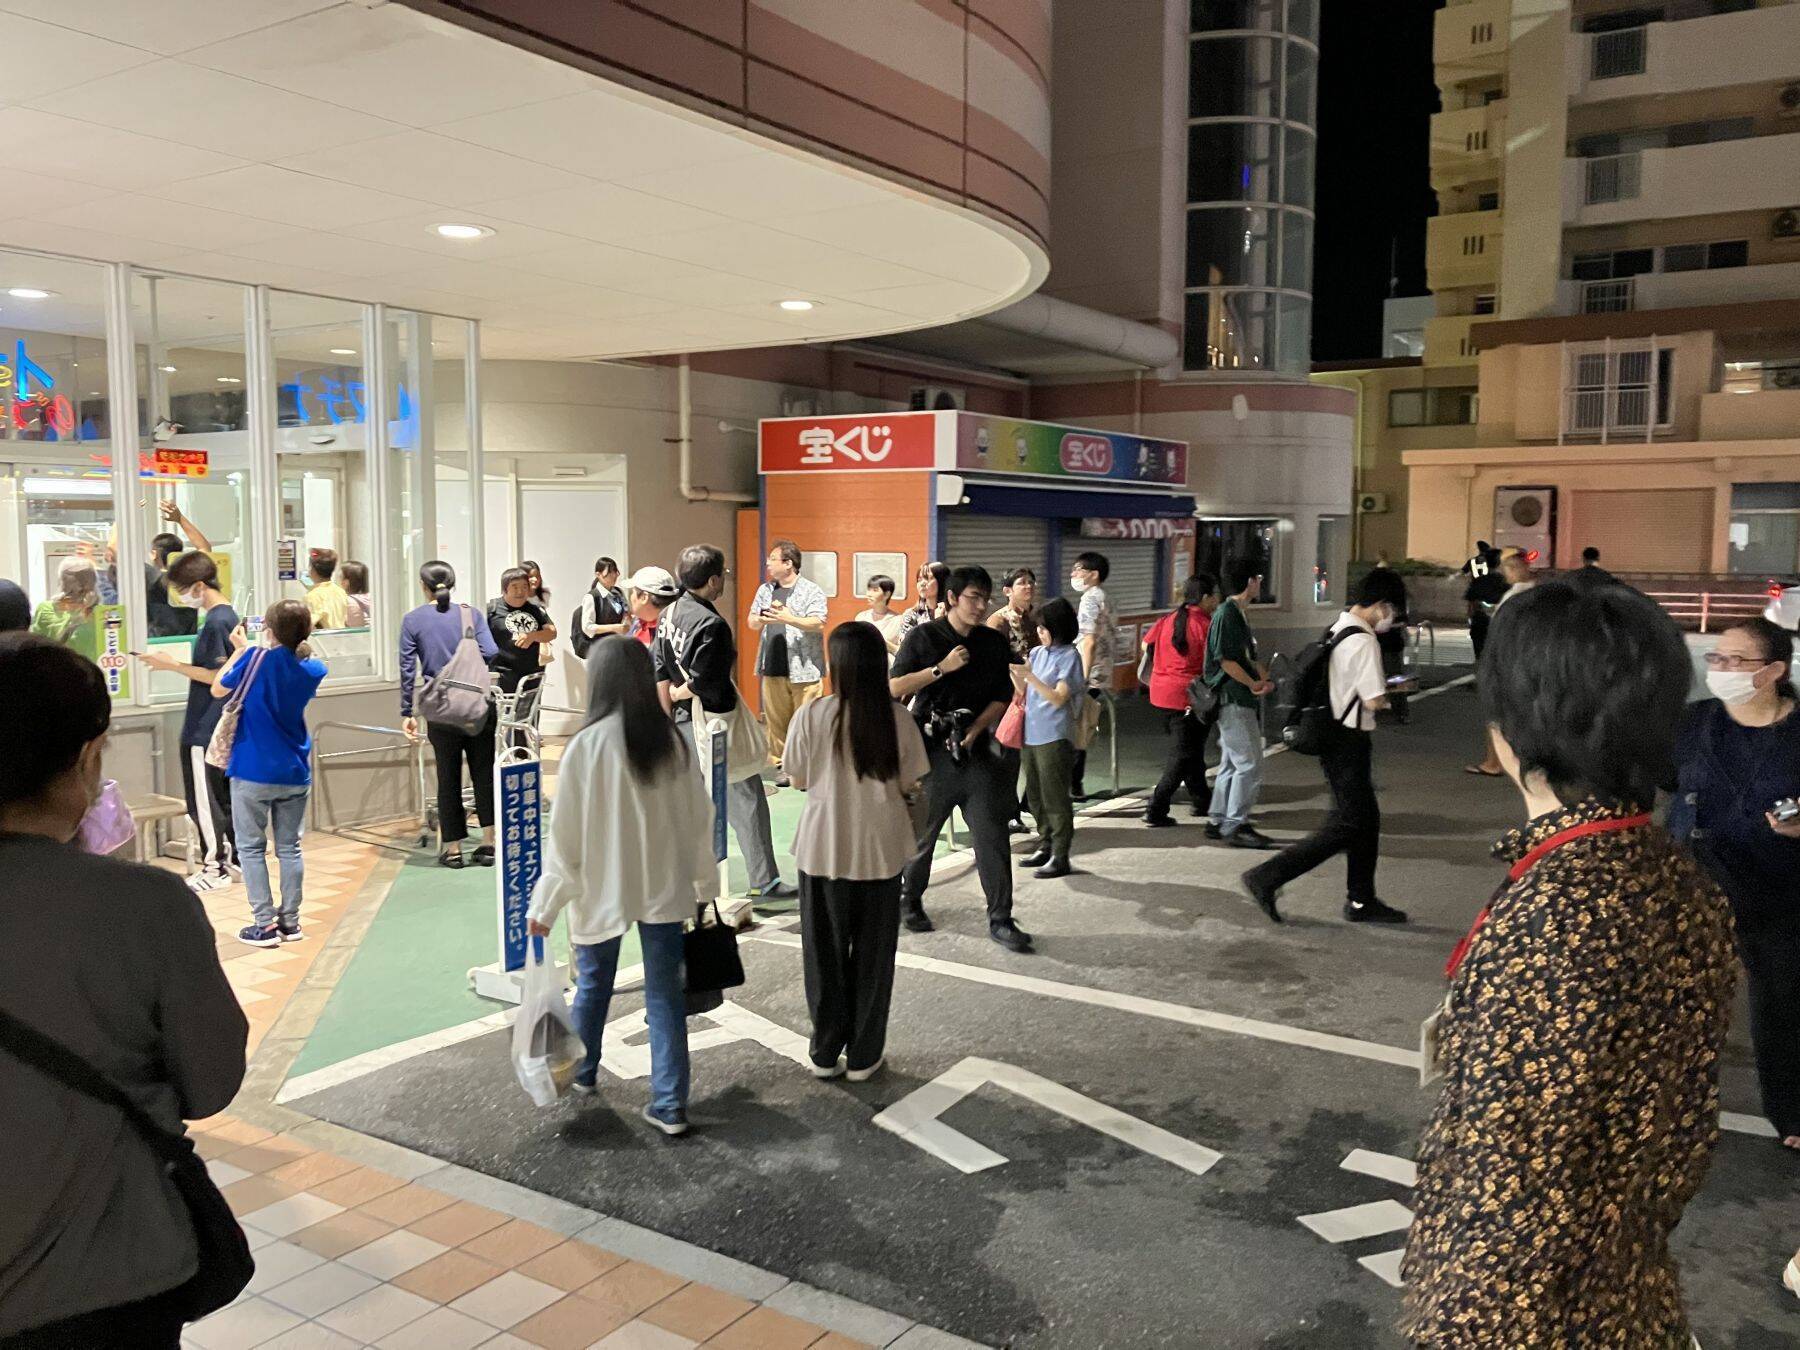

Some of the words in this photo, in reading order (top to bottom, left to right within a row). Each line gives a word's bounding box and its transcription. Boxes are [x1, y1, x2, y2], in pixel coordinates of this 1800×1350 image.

[799, 425, 893, 464] 宝くじ
[1068, 440, 1106, 467] 宝くじ
[101, 656, 125, 668] 110
[505, 774, 522, 950] 切ってお待ちください。
